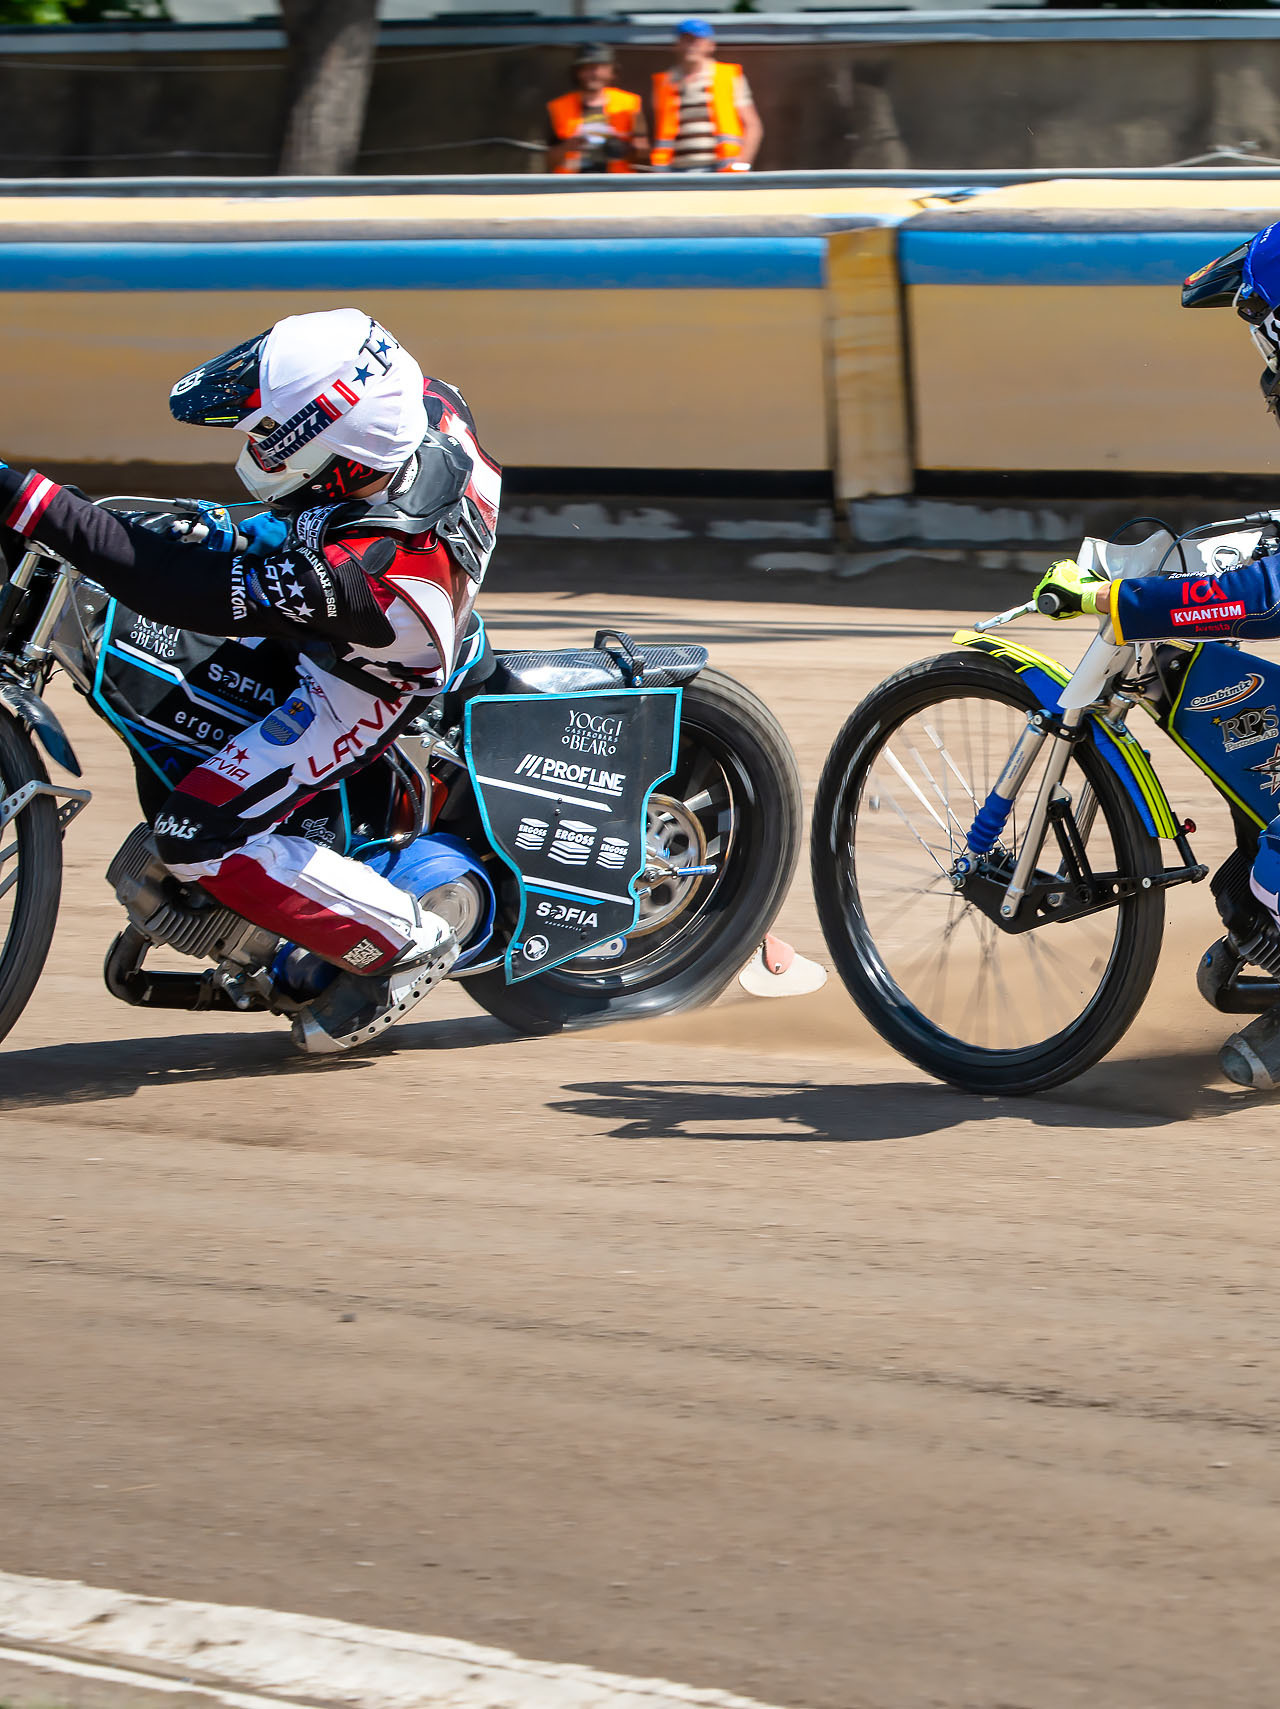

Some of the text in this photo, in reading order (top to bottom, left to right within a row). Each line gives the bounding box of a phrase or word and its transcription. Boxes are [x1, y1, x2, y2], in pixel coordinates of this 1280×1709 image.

[262, 410, 320, 460] SCOTT
[1182, 579, 1228, 605] ICA
[1174, 604, 1242, 623] KVANTUM
[1191, 680, 1251, 706] Combimix
[569, 709, 623, 737] YOGGI
[1219, 705, 1279, 744] RPS
[569, 734, 608, 757] BEAR
[204, 757, 251, 782] TVIA
[542, 758, 627, 792] PROFLINE
[518, 824, 548, 837] ERGOSS
[554, 828, 595, 847] ERGOSS
[600, 843, 628, 856] ERGOSS
[536, 901, 598, 928] SOFIA
